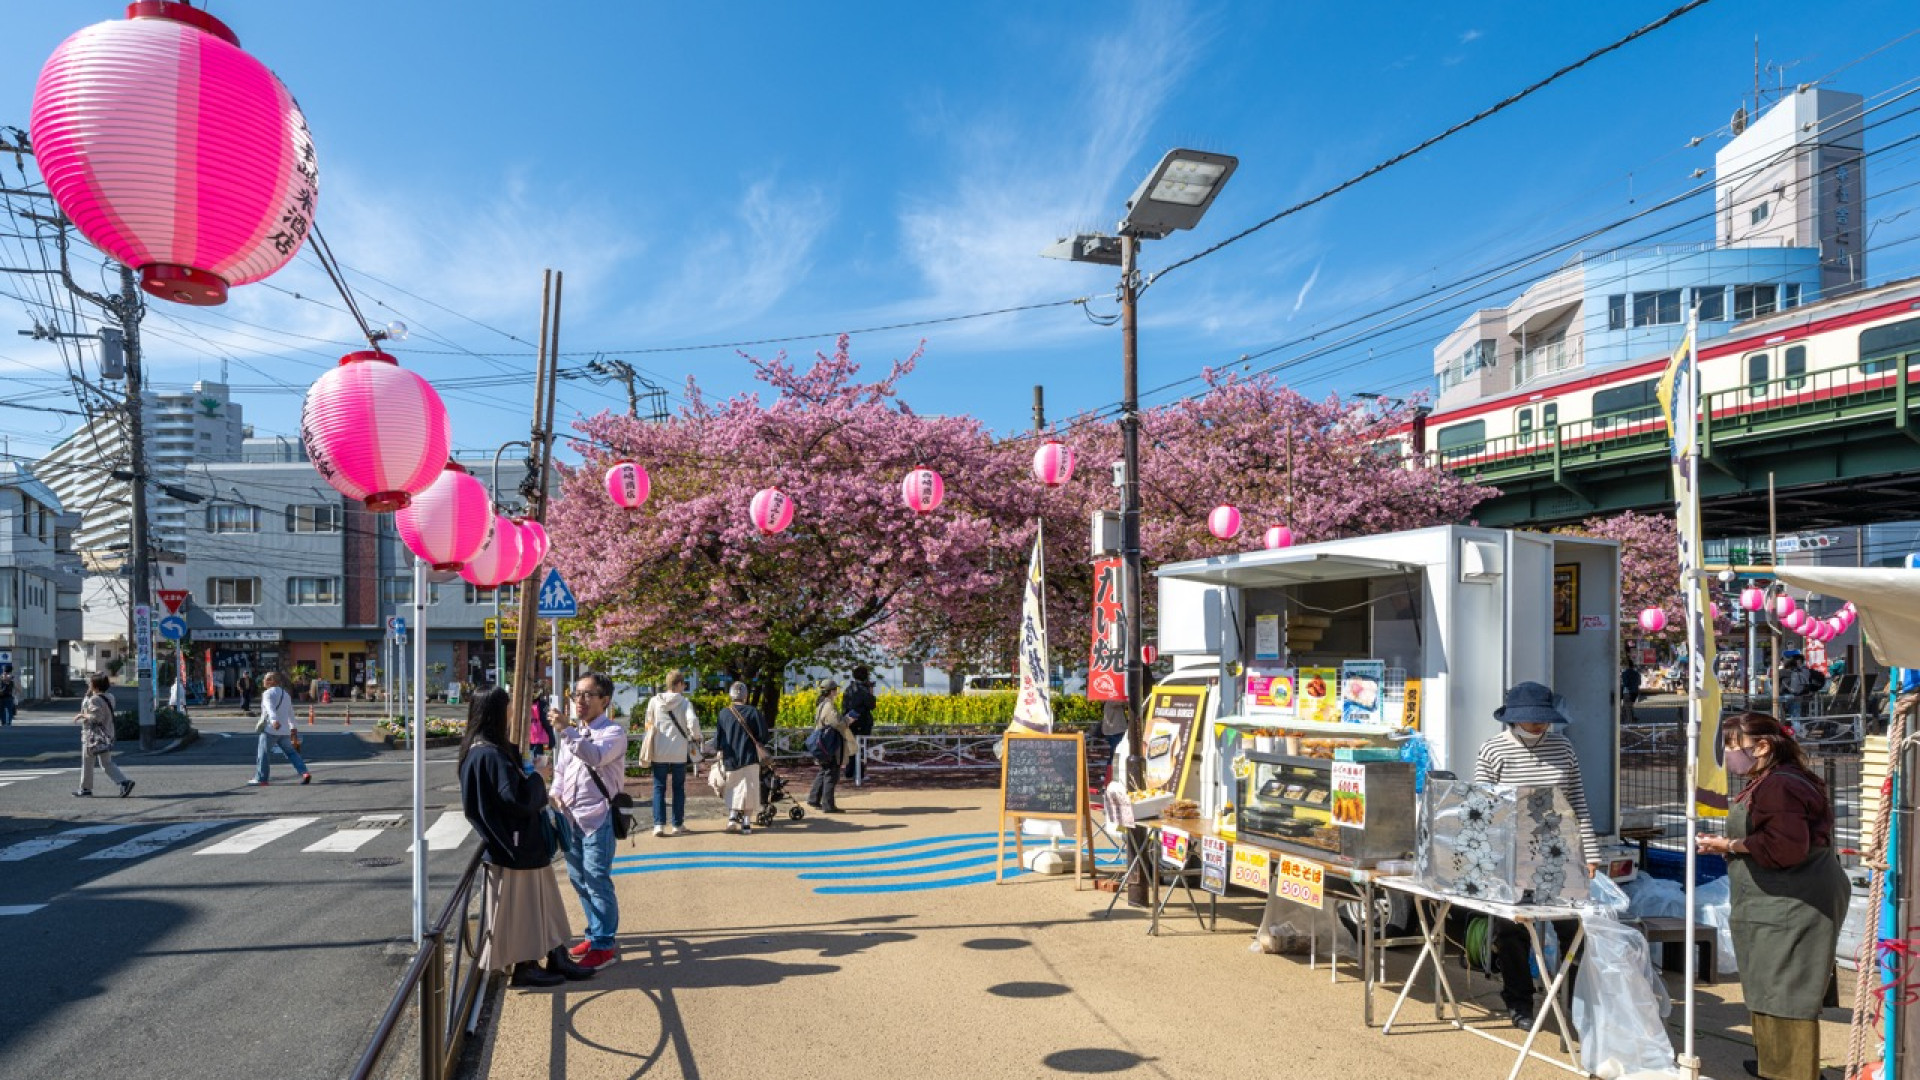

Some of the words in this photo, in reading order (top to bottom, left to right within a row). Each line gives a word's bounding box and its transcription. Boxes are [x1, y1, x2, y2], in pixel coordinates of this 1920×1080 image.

[1236, 867, 1267, 888] 500円
[1281, 860, 1323, 884] 焼きそば
[1281, 880, 1320, 904] 500円
